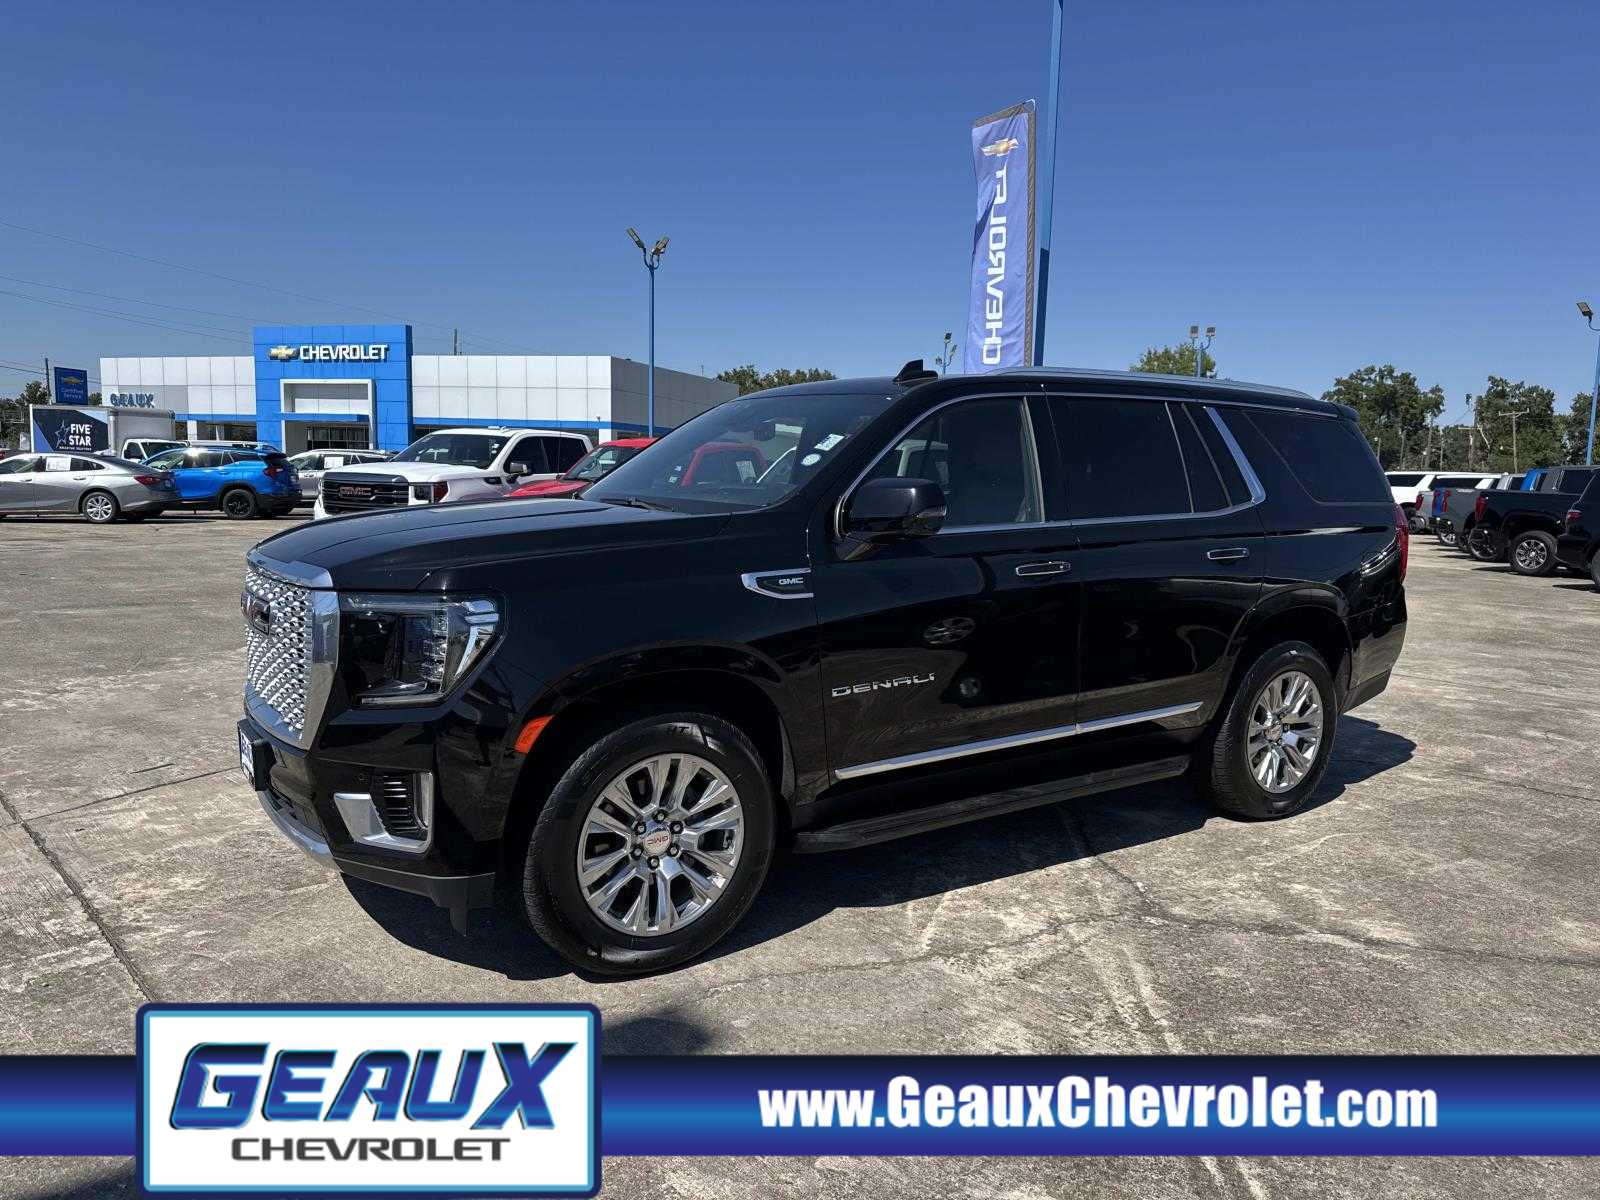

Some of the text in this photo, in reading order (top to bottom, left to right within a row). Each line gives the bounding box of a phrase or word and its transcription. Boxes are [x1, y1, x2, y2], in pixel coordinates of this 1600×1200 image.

[300, 344, 387, 360] CHEVROLET
[110, 393, 155, 408] GEAUX
[70, 423, 91, 434] FIVE
[68, 435, 91, 446] STAR
[339, 486, 372, 496] GMC
[778, 576, 804, 586] GMC
[831, 672, 936, 698] DENALI
